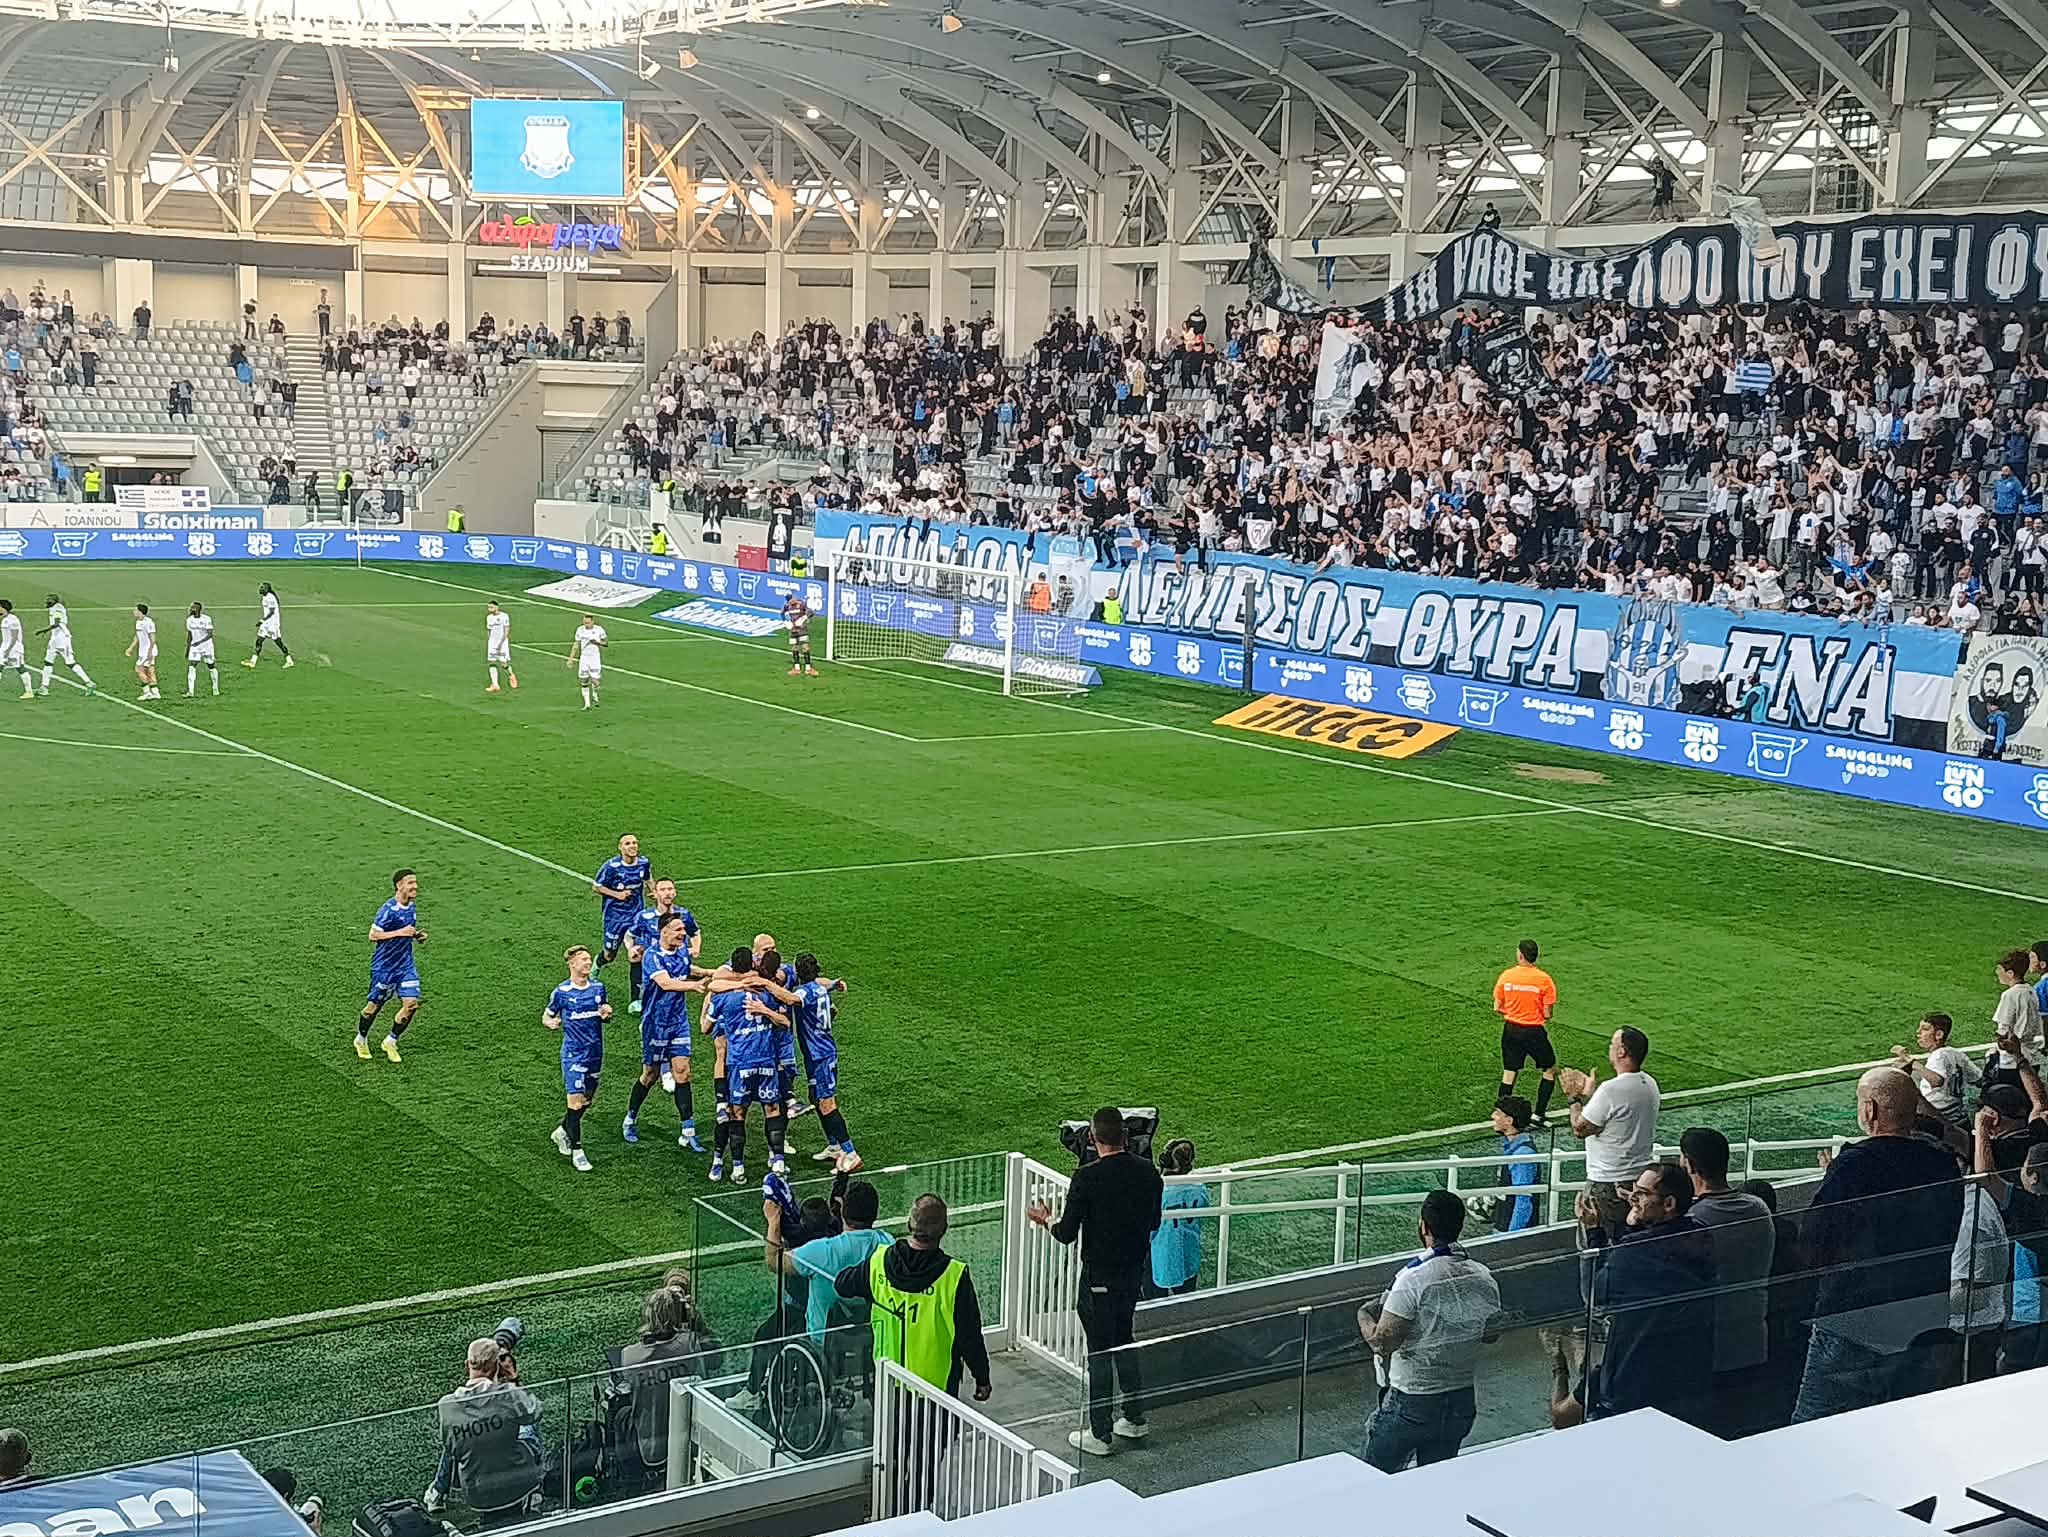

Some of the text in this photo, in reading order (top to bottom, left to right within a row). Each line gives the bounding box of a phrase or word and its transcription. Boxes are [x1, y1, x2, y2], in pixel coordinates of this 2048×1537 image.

[510, 255, 590, 273] STADIUM
[1848, 225, 1975, 302] ΕΧΕΙ
[64, 515, 122, 527] IOANNOU
[144, 512, 257, 530] Stoiximan
[1398, 591, 1579, 690] ΘΥΡΑ
[1725, 625, 1897, 738] ΕΝΑ
[452, 1414, 503, 1440] PHOTO
